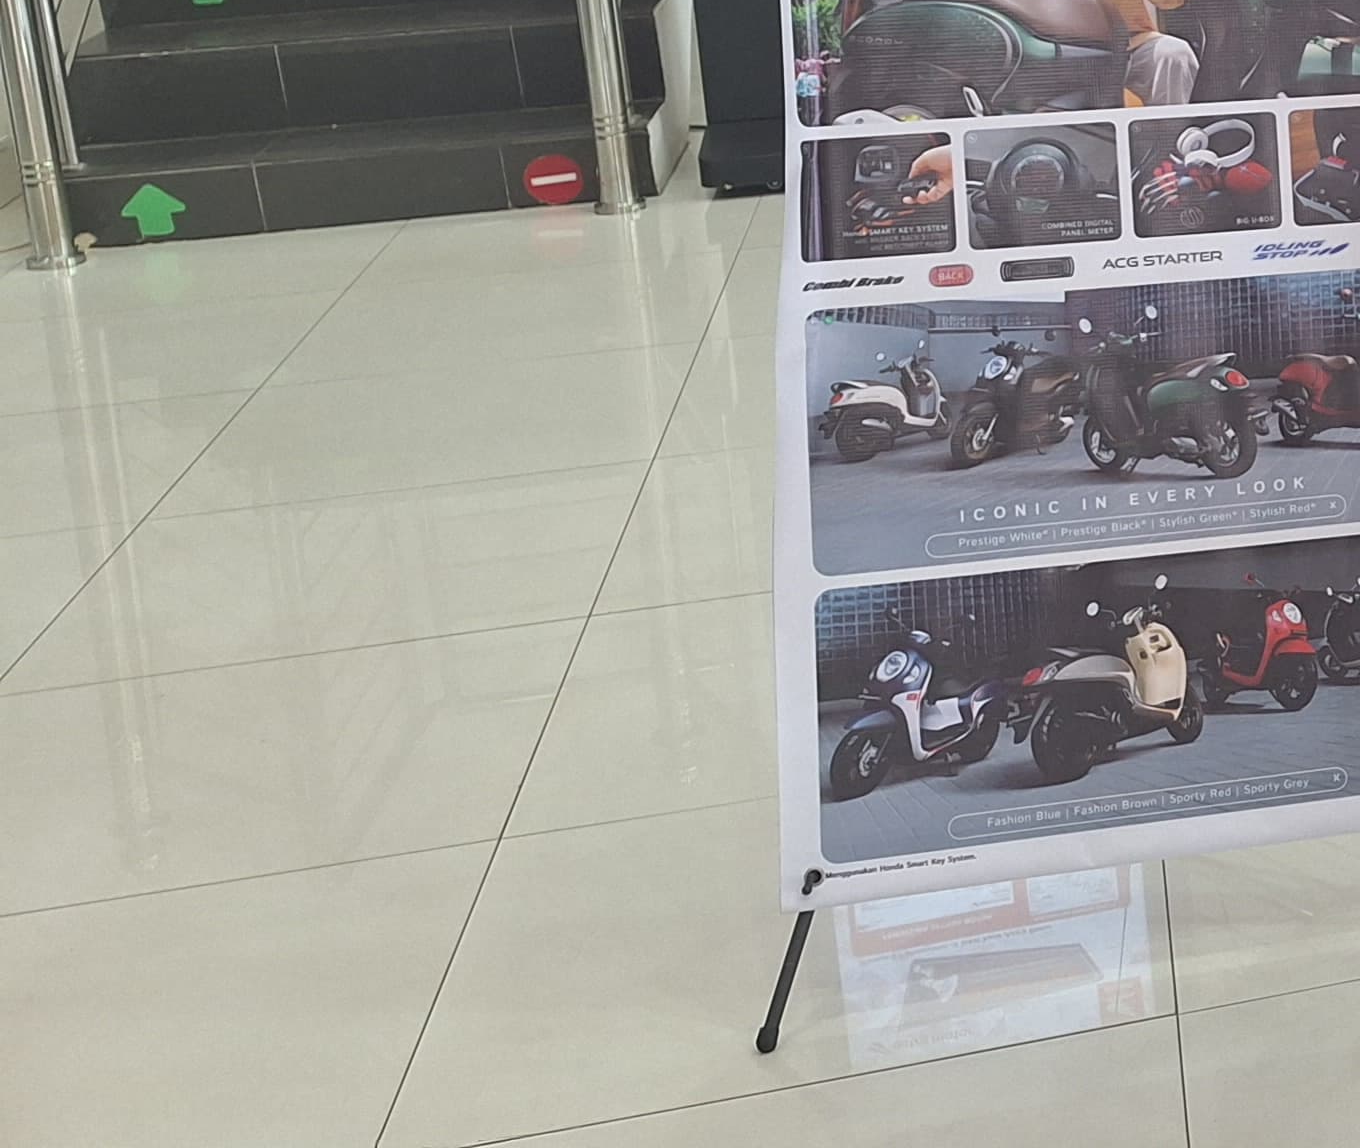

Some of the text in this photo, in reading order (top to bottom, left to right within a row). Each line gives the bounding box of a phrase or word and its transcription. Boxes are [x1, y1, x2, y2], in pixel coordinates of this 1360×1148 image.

[917, 223, 949, 234] SYSTEM
[1255, 239, 1326, 252] IDLING
[1102, 250, 1224, 270] ACG STARTER
[1251, 250, 1302, 261] STOP
[803, 275, 905, 292] Combi Brake
[959, 476, 1306, 523] ICONIC IN EVERY LOOK
[958, 536, 1006, 549] Prestige
[1061, 524, 1107, 538] Prestige
[1159, 515, 1196, 529] Stylish
[1249, 506, 1285, 519] Stylish
[987, 777, 1310, 828] Fashion Blue Fashion Brown Sporty Red Sporty Grey
[880, 863, 904, 872] Honda
[906, 859, 929, 869] Smart
[931, 858, 946, 866] Key
[947, 853, 977, 863] System.
